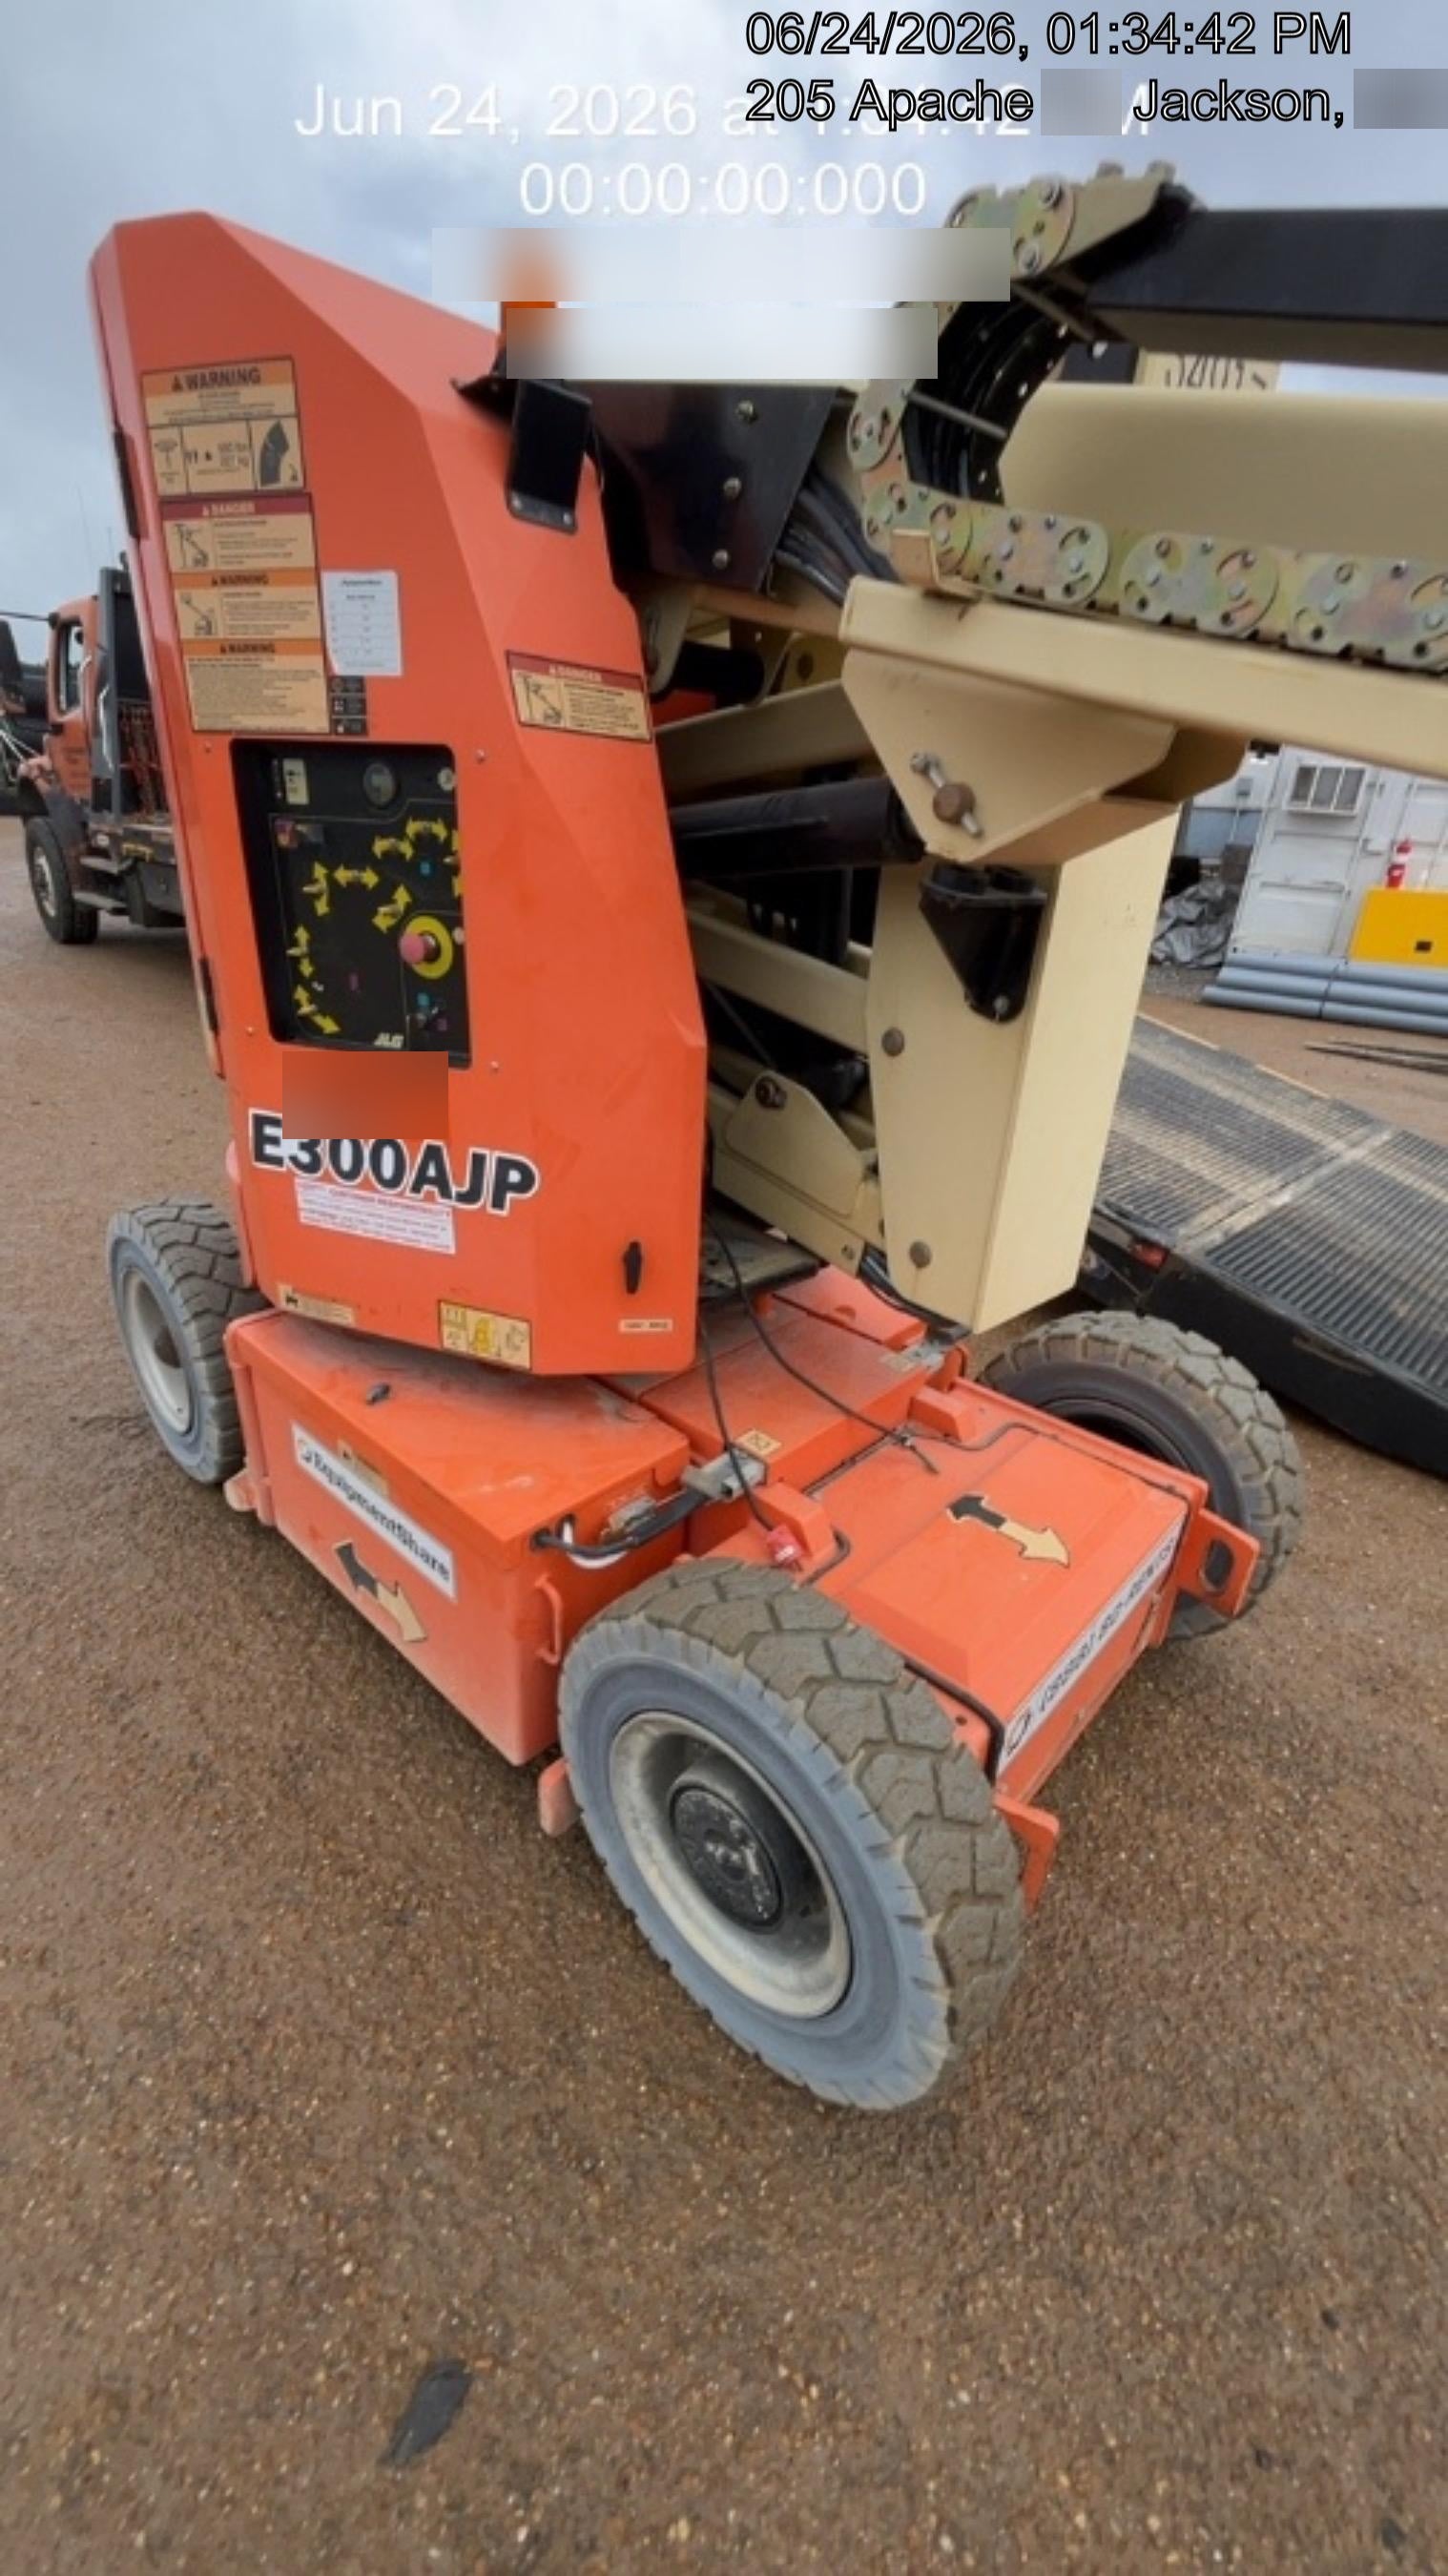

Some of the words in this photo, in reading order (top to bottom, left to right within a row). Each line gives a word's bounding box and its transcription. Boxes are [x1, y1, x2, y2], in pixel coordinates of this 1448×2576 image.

[185, 366, 261, 390] WARNING
[211, 502, 257, 517] DANGER
[219, 574, 270, 586] WARNING
[228, 643, 276, 654] WARNING
